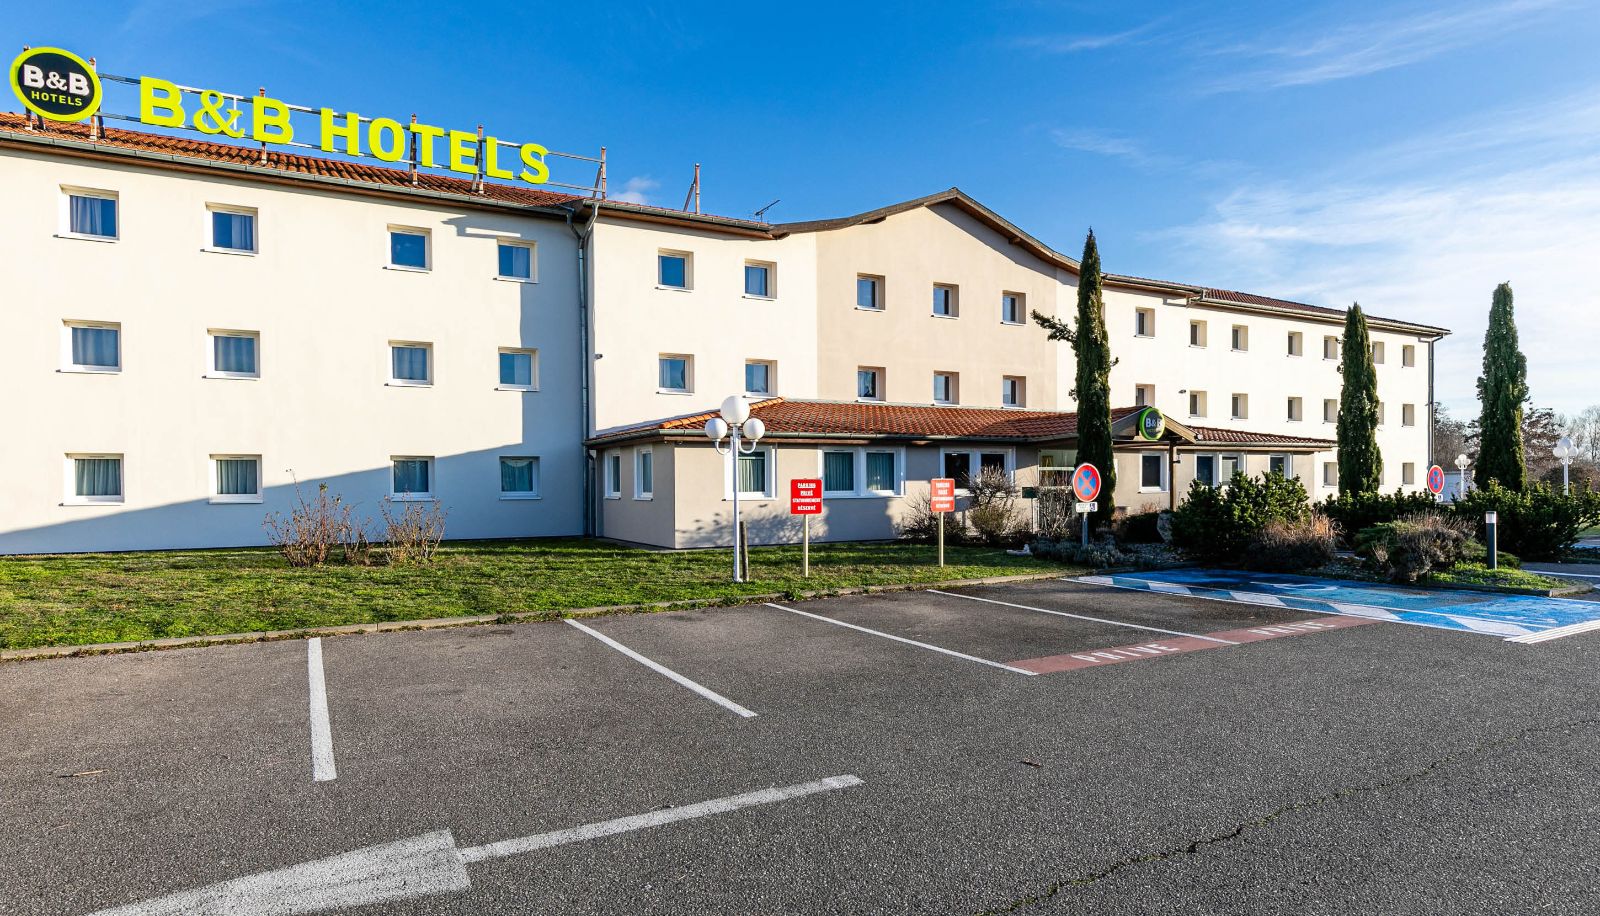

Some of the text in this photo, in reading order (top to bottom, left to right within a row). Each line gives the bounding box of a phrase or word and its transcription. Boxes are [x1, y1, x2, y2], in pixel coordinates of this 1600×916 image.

[23, 64, 90, 96] B&B
[31, 90, 83, 107] HOTELS
[140, 76, 550, 184] B&B HOTELS
[1070, 643, 1180, 663] PRIVE
